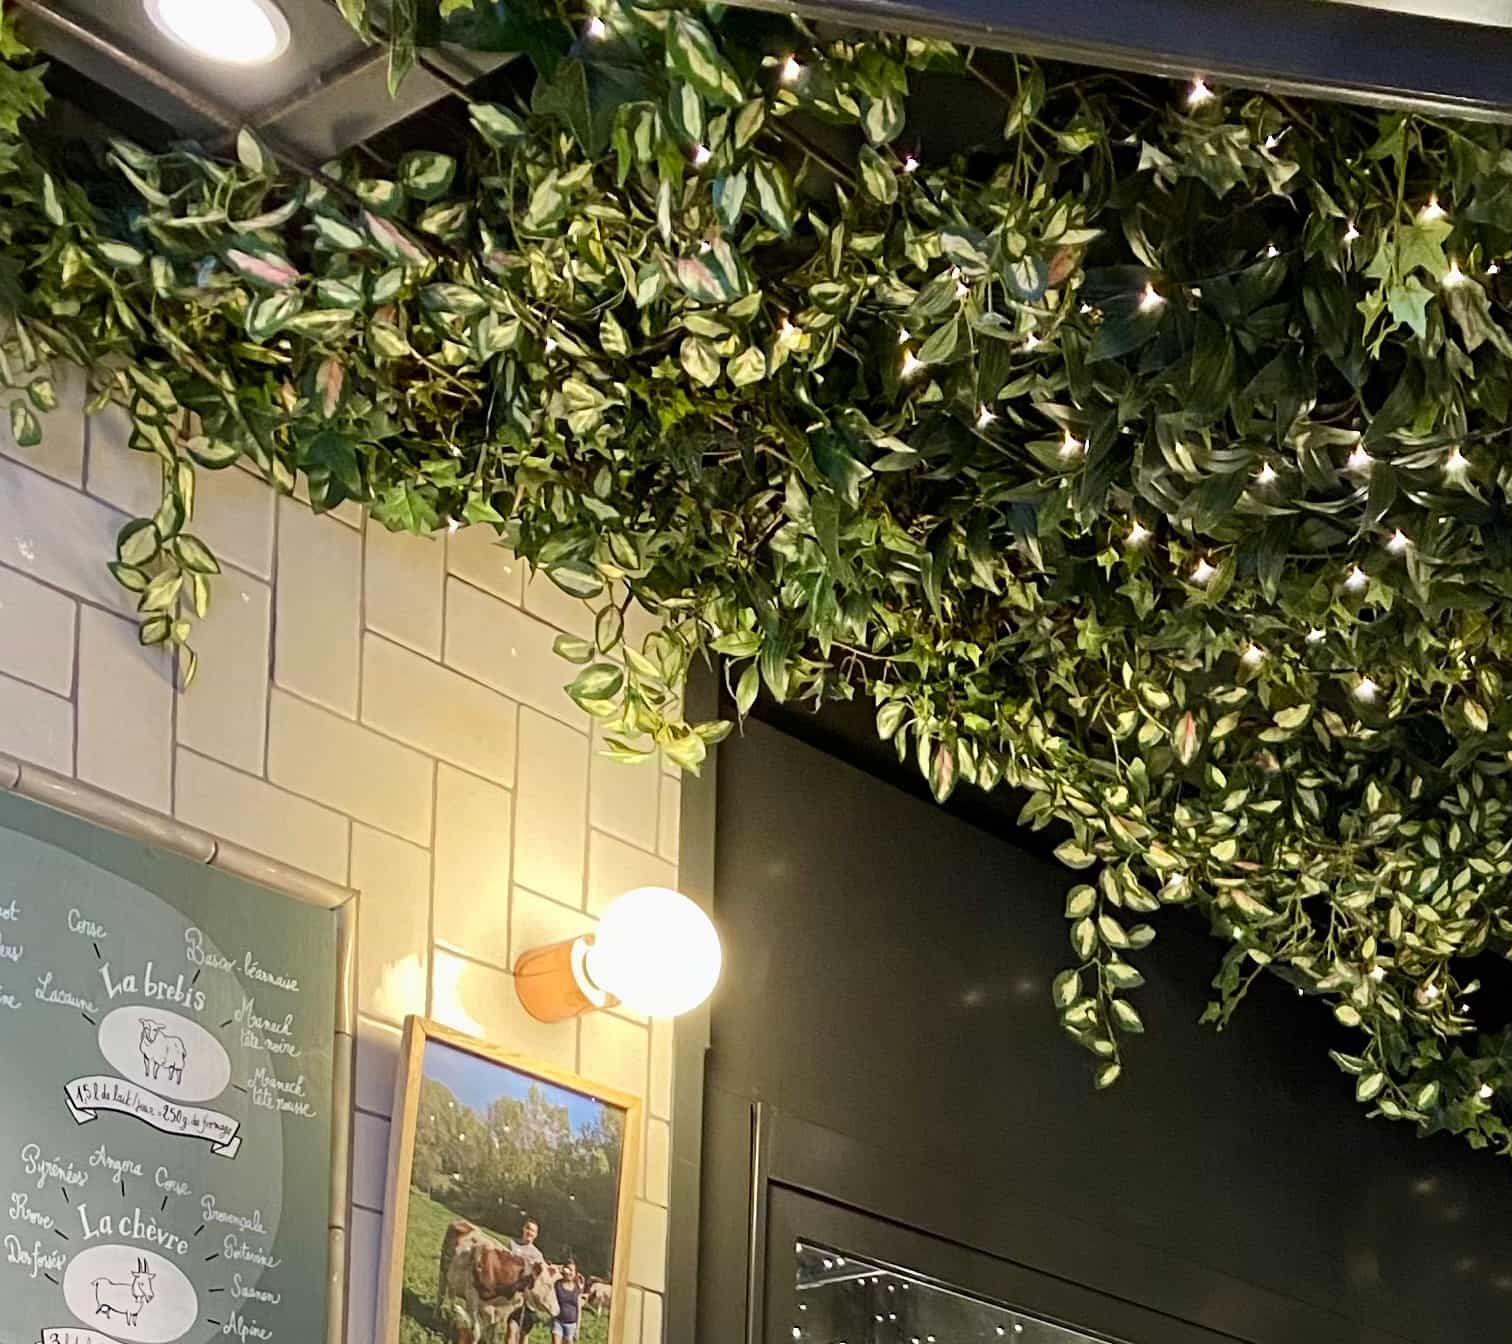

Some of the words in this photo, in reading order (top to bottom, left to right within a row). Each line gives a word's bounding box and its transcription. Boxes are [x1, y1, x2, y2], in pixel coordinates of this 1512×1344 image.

[99, 962, 138, 999] La
[144, 961, 206, 1011] brebis
[77, 1203, 113, 1240] La
[118, 1207, 189, 1255] chèvre
[223, 1311, 273, 1344] Alpine
